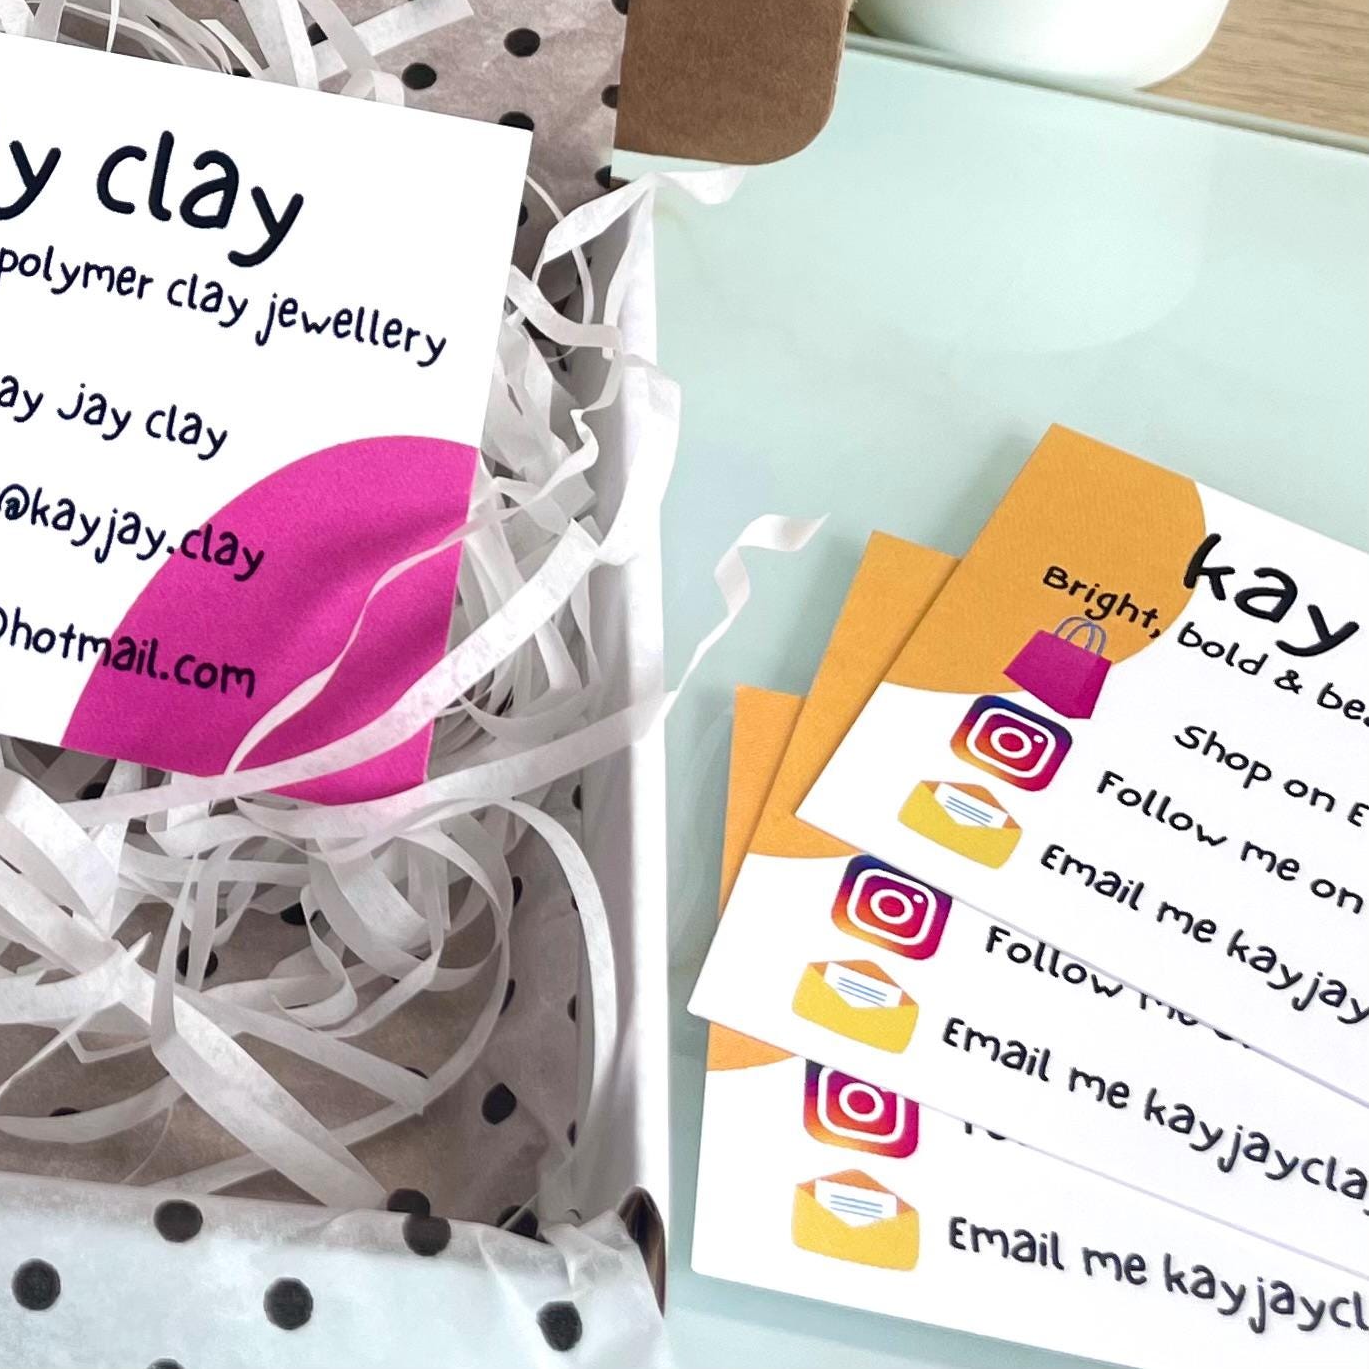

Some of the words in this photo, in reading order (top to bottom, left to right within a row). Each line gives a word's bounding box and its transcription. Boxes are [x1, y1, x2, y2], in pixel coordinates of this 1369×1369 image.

[96, 130, 304, 268] clay
[167, 273, 249, 329] clay
[255, 290, 447, 368] jewellery
[56, 383, 132, 441] jay
[145, 404, 228, 461] clay
[1183, 533, 1360, 658] kay
[1042, 565, 1161, 639] Bright,
[1177, 621, 1269, 676] bold
[1273, 669, 1303, 695] &
[1316, 682, 1369, 728] be
[1174, 725, 1272, 789] Shop
[1283, 779, 1336, 813] on
[1096, 770, 1228, 847] Follow
[1240, 841, 1300, 881] me
[1310, 878, 1364, 915] on
[1040, 844, 1145, 911] Email
[1156, 901, 1217, 943] me
[985, 925, 1124, 998] Follow
[942, 1017, 1051, 1082] Email
[1069, 1067, 1130, 1109] me
[1144, 1088, 1369, 1217] kayjaycla
[949, 1216, 1065, 1271] Email
[1083, 1248, 1147, 1286] me
